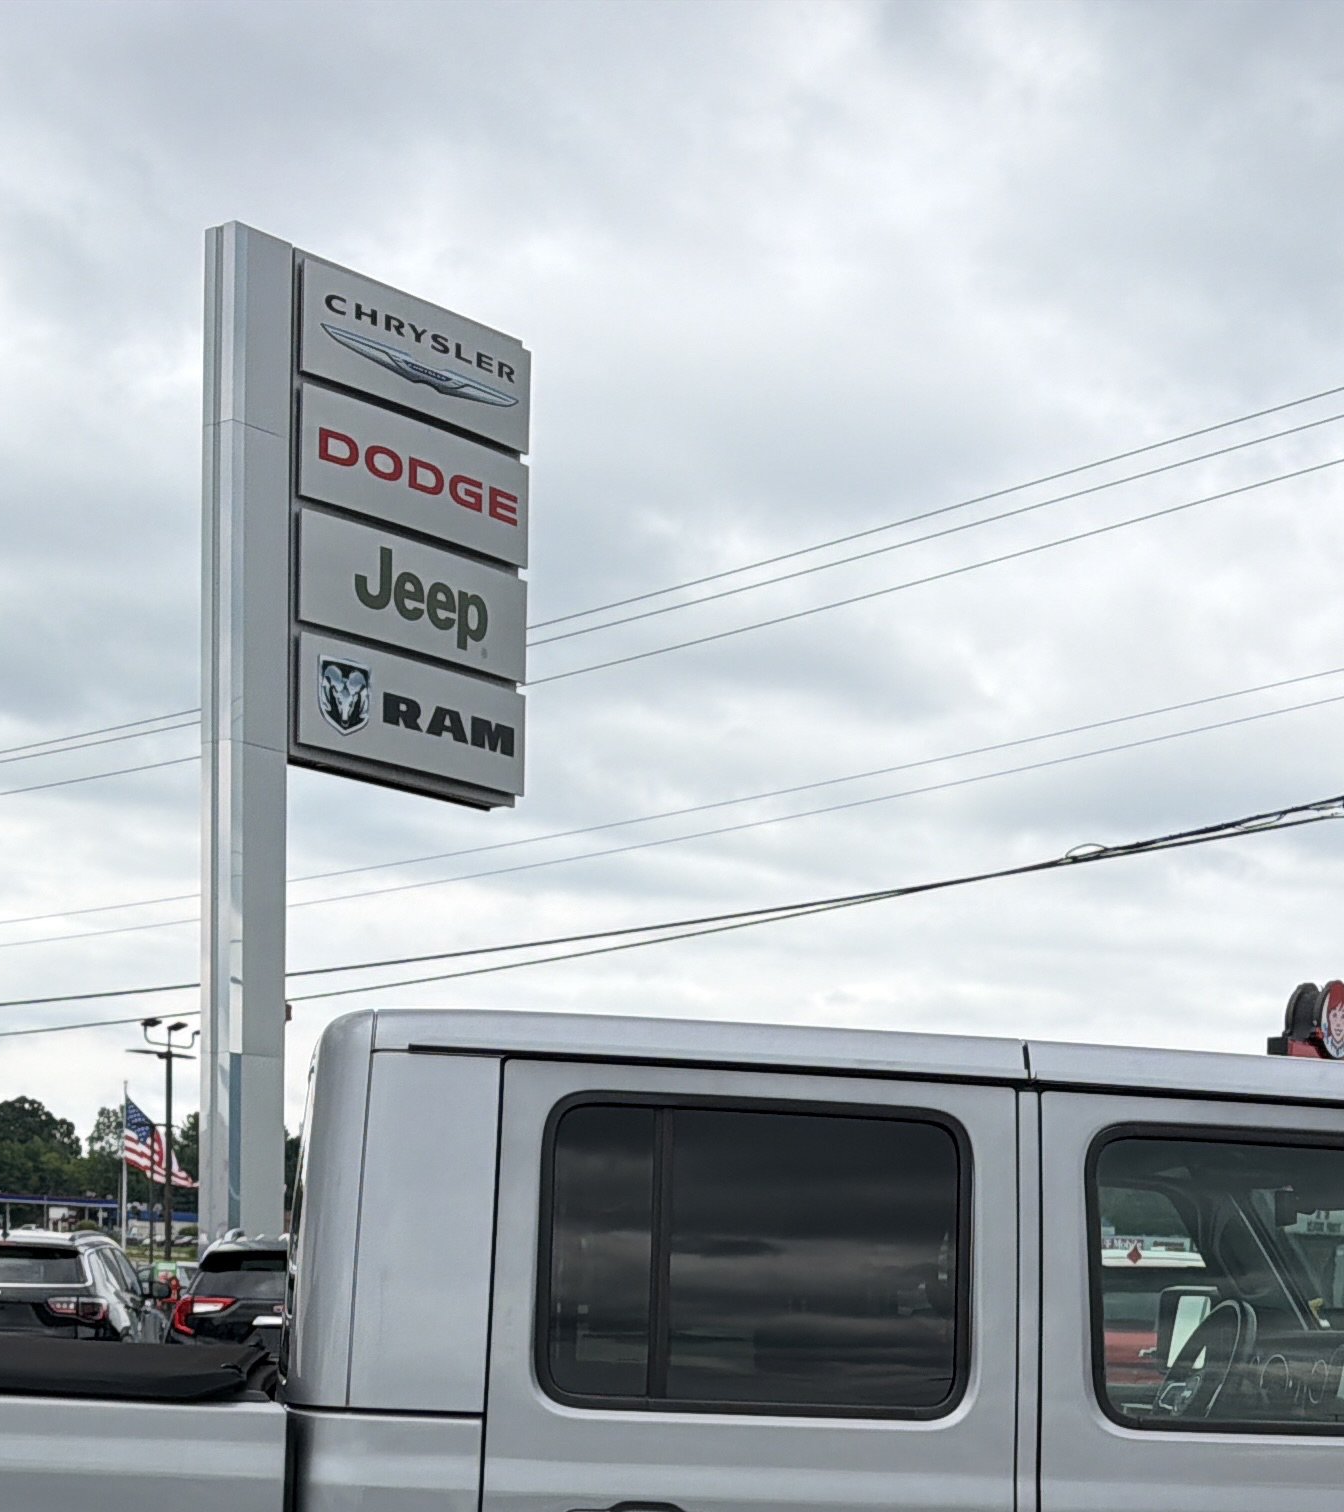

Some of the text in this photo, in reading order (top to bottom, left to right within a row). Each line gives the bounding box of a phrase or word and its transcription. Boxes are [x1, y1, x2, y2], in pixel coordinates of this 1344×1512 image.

[324, 294, 515, 384] CHRYSLER
[318, 427, 518, 526] DODGE
[355, 546, 488, 650] Jeep
[382, 691, 515, 757] RAM
